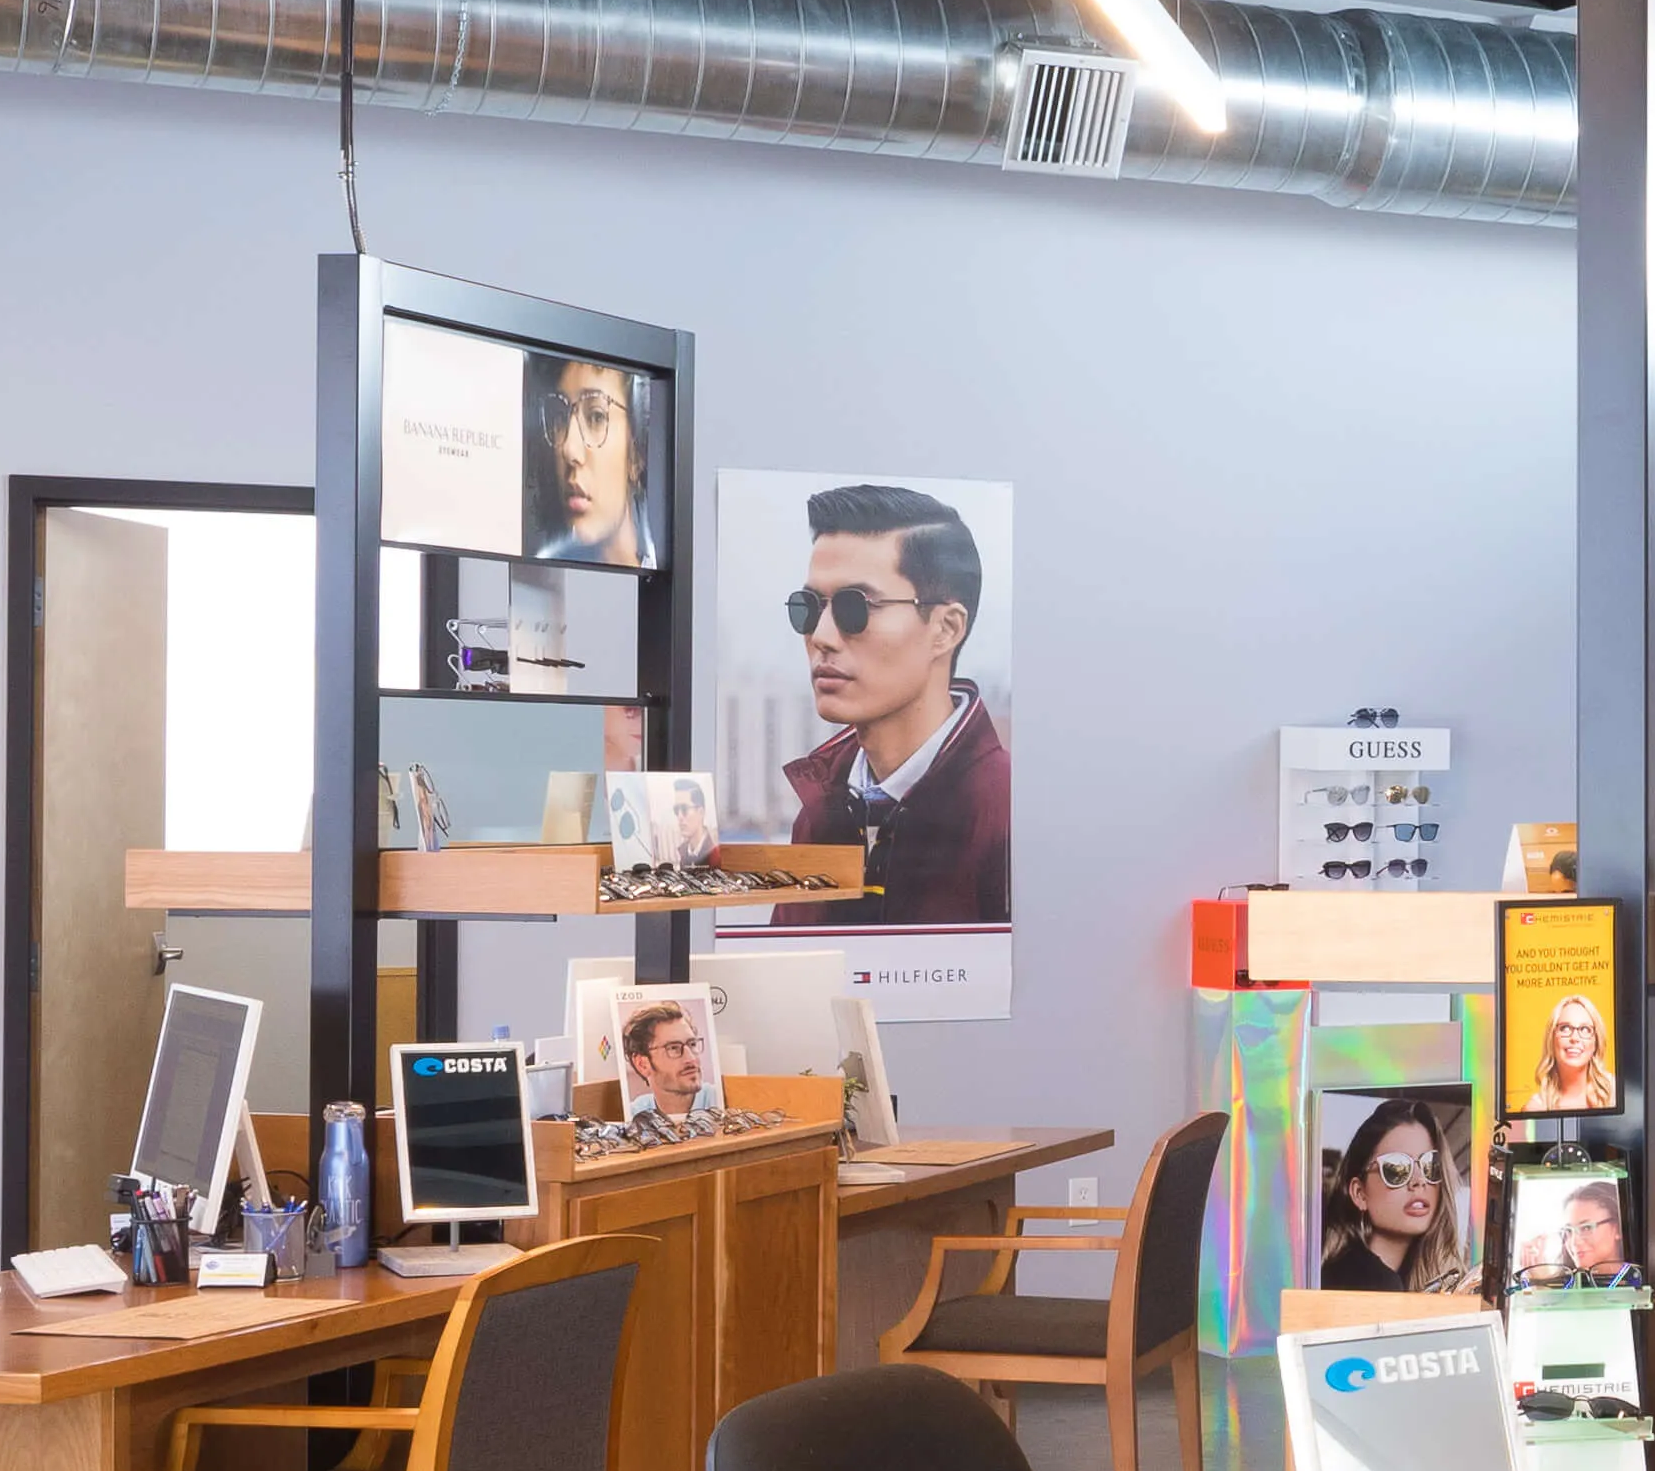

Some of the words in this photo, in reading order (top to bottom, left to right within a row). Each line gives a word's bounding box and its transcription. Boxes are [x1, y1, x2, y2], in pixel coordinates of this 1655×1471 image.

[403, 418, 450, 442] BANANA
[451, 426, 504, 450] REPUBLIC
[1349, 740, 1422, 759] GUESS
[1516, 948, 1536, 959] AND
[1538, 947, 1556, 959] YOU
[1559, 946, 1600, 957] THOUGHT
[1505, 963, 1523, 975] YOU
[1572, 961, 1589, 972] GET
[1592, 960, 1610, 971] ANY
[879, 968, 968, 984] HILFIGER
[1517, 978, 1543, 989] MORE
[616, 992, 643, 1001] IZOD
[444, 1057, 507, 1074] COSTA
[1376, 1347, 1481, 1384] COSTA
